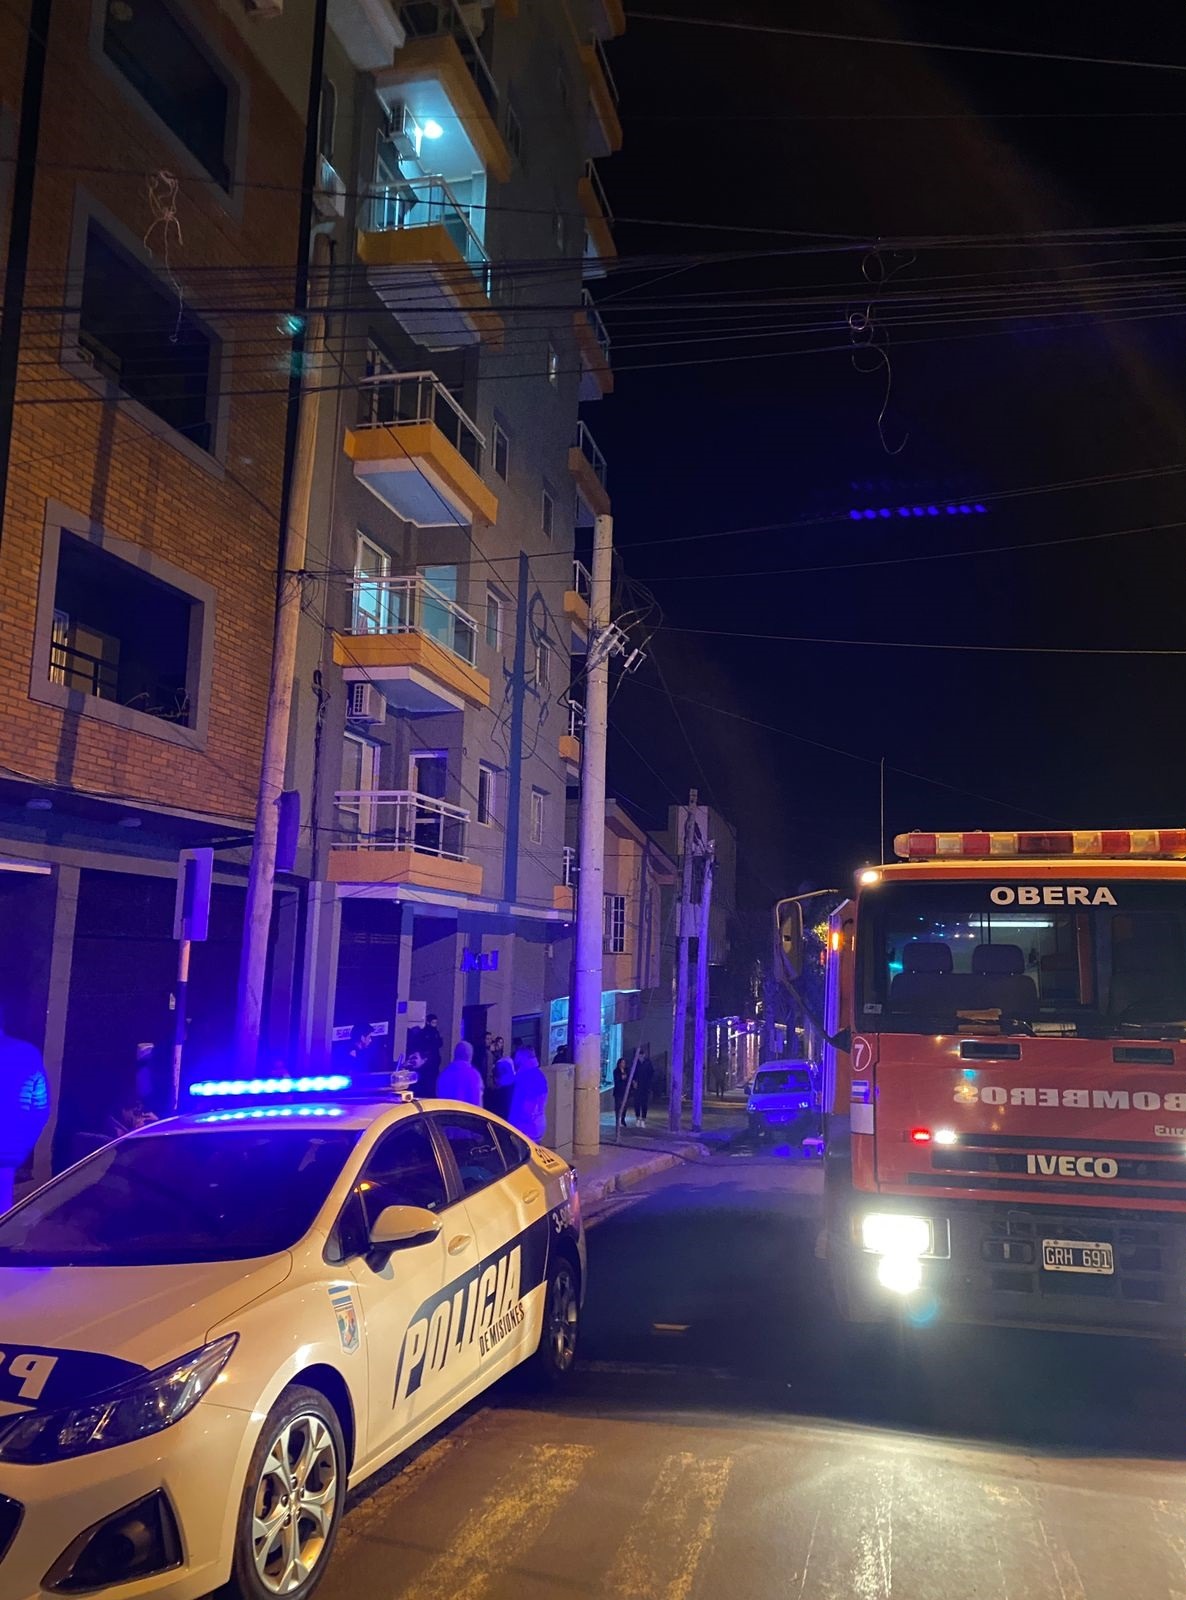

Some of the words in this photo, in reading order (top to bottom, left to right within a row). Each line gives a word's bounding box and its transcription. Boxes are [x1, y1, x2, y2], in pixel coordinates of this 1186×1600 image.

[990, 886, 1118, 906] OBERA
[854, 1044, 864, 1067] 7
[1026, 1154, 1118, 1178] IVECO
[1046, 1247, 1073, 1265] GRH
[1082, 1249, 1110, 1268] 691
[396, 1245, 522, 1400] POLICIA
[479, 1333, 490, 1357] DE
[490, 1302, 525, 1348] MISIONES
